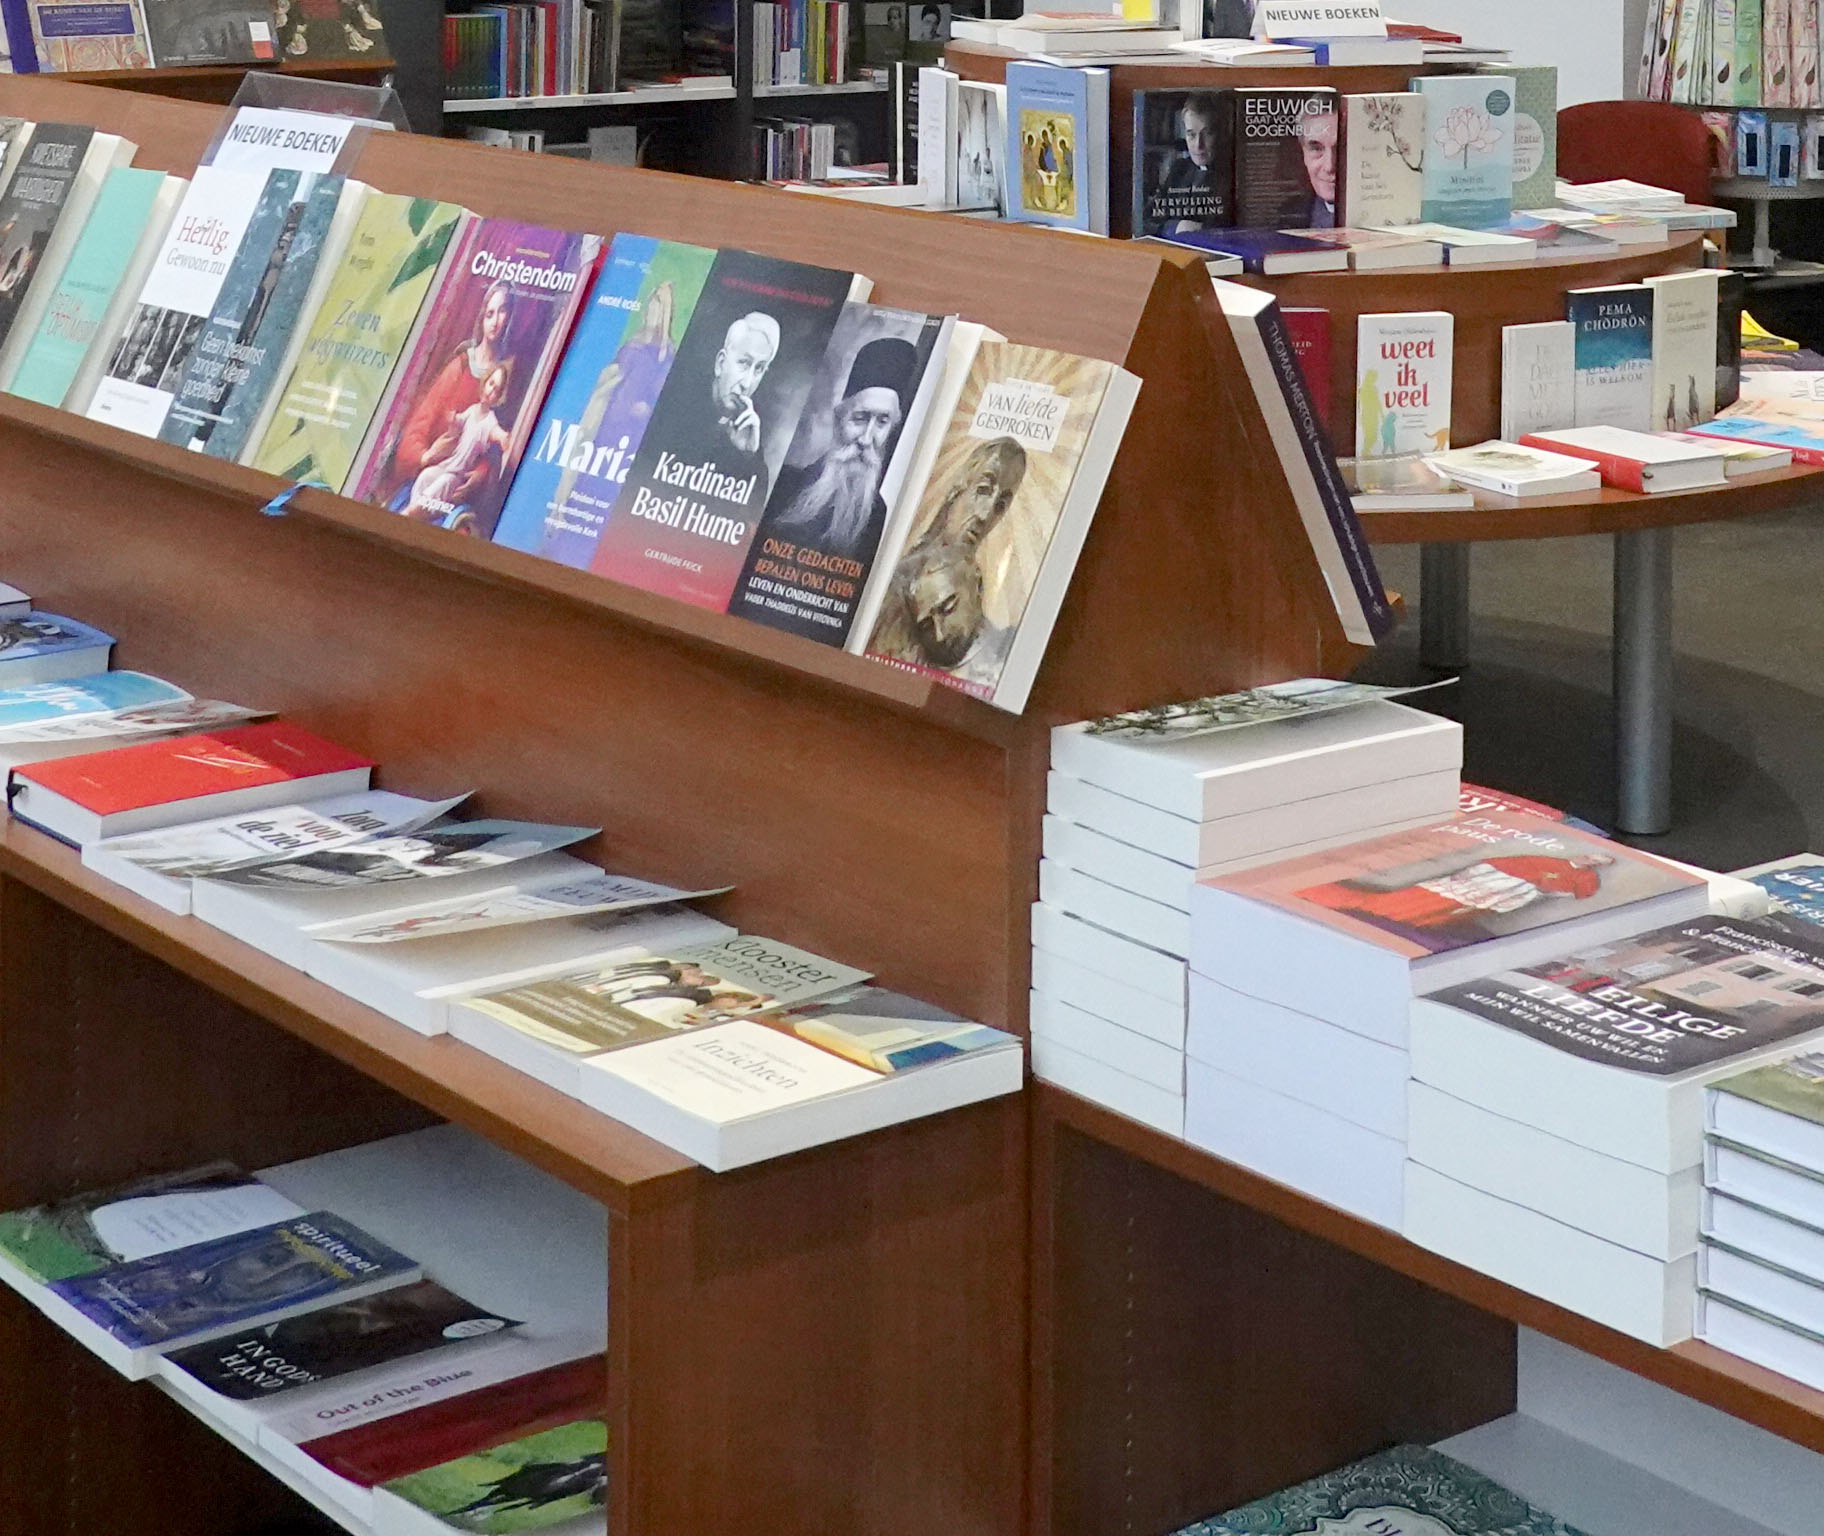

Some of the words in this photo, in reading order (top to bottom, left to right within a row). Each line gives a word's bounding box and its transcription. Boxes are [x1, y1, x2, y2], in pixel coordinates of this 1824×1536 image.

[1265, 8, 1322, 21] NIEUWE
[1325, 7, 1380, 20] BOEKEN
[1245, 97, 1334, 116] EEUWIGH
[1245, 115, 1273, 125] GAAT
[1274, 115, 1301, 124] VOOR
[229, 123, 282, 148] NIEUWE
[283, 130, 342, 155] BOEKEN
[1152, 208, 1163, 217] IN
[1165, 206, 1224, 217] BEKERING
[1153, 195, 1223, 208] VERVULLING
[166, 248, 210, 275] Gewoon
[209, 256, 225, 275] nu
[471, 250, 577, 293] Christendom
[1584, 316, 1647, 331] CHÖDRÖN
[1599, 303, 1633, 315] PEMA
[1380, 337, 1436, 360] weet
[1268, 320, 1295, 382] THOMAS
[1288, 379, 1320, 442] MERTON
[1396, 360, 1418, 387] ik
[987, 393, 1014, 410] VAN
[1015, 391, 1058, 422] liefde
[1384, 381, 1430, 409] veel
[976, 412, 1055, 441] GESPROKEN
[534, 418, 634, 485] Maria
[652, 451, 757, 505] Kardinaal
[630, 486, 683, 528] Basil
[685, 502, 746, 546] Hume
[762, 537, 796, 561] ONZE
[796, 547, 864, 578] GEDACHTEN
[754, 558, 800, 583] BEPALEN
[801, 571, 825, 590] ONS
[825, 578, 856, 598] LEVEN
[748, 576, 775, 593] LEVEN
[773, 583, 785, 596] EN
[833, 600, 850, 614] VAN
[797, 607, 813, 620] VAN
[236, 819, 263, 833] de
[260, 827, 315, 850] ziel
[297, 816, 351, 841] voor
[1435, 823, 1501, 844] paus
[1460, 817, 1501, 830] De
[1499, 828, 1566, 851] rode
[721, 938, 839, 985] Klooster
[1464, 992, 1508, 1010] MIJN
[1508, 1006, 1541, 1024] WIL
[1540, 1020, 1667, 1064] SAMENVALLEN
[1495, 991, 1575, 1025] WANNEER
[1576, 1022, 1608, 1037] UW
[1606, 1032, 1640, 1048] WIL
[1641, 1045, 1669, 1056] EN
[1518, 984, 1685, 1044] LIEFDE
[693, 1037, 798, 1089] Inzichten
[236, 1339, 266, 1360] IN
[219, 1353, 284, 1391] HAND
[316, 1401, 359, 1421] Out
[361, 1392, 385, 1411] of
[387, 1381, 424, 1404] the
[426, 1366, 474, 1389] Blue
